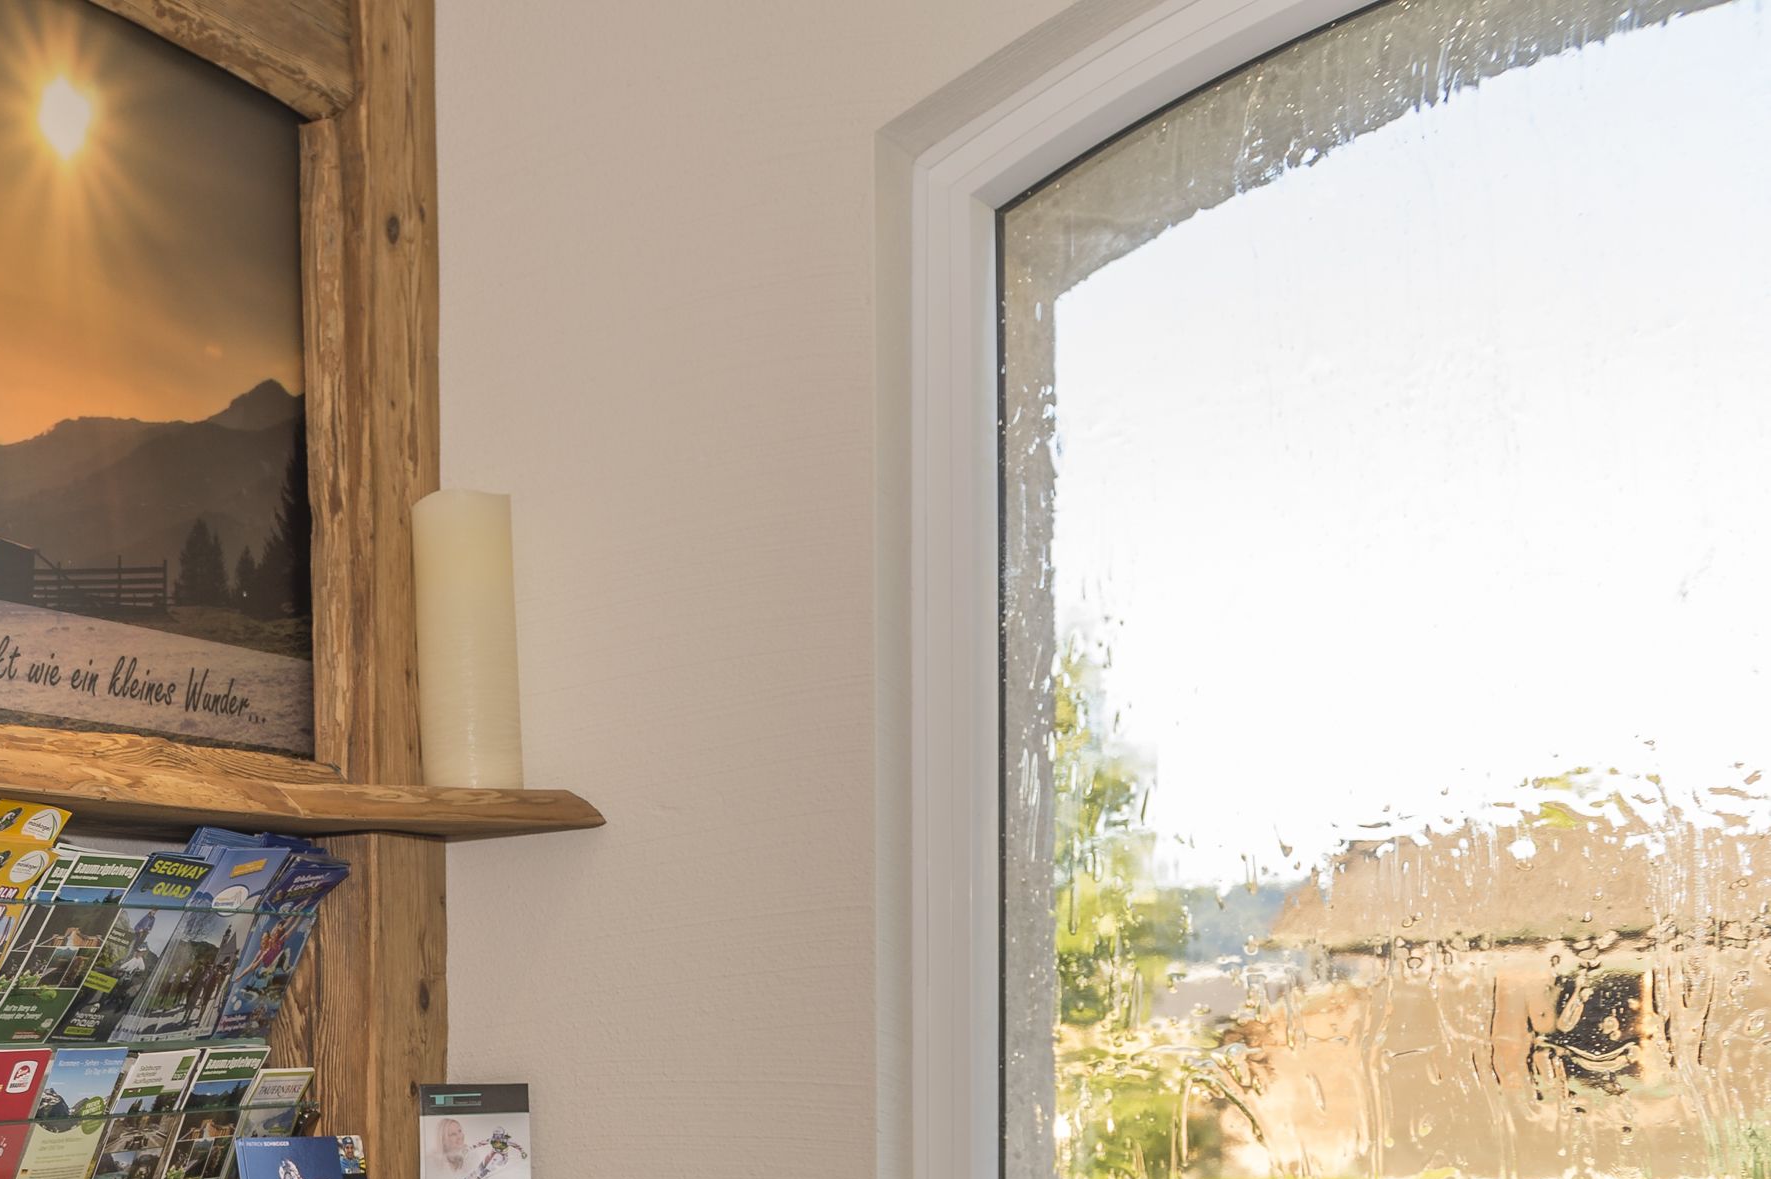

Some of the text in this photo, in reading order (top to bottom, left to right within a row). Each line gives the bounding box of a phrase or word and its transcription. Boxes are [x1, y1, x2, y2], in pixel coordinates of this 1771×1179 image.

[28, 653, 61, 686] wie
[71, 659, 100, 696] ein
[108, 656, 176, 705] kleines
[150, 859, 208, 880] SEGWAY
[151, 881, 192, 899] QUAD
